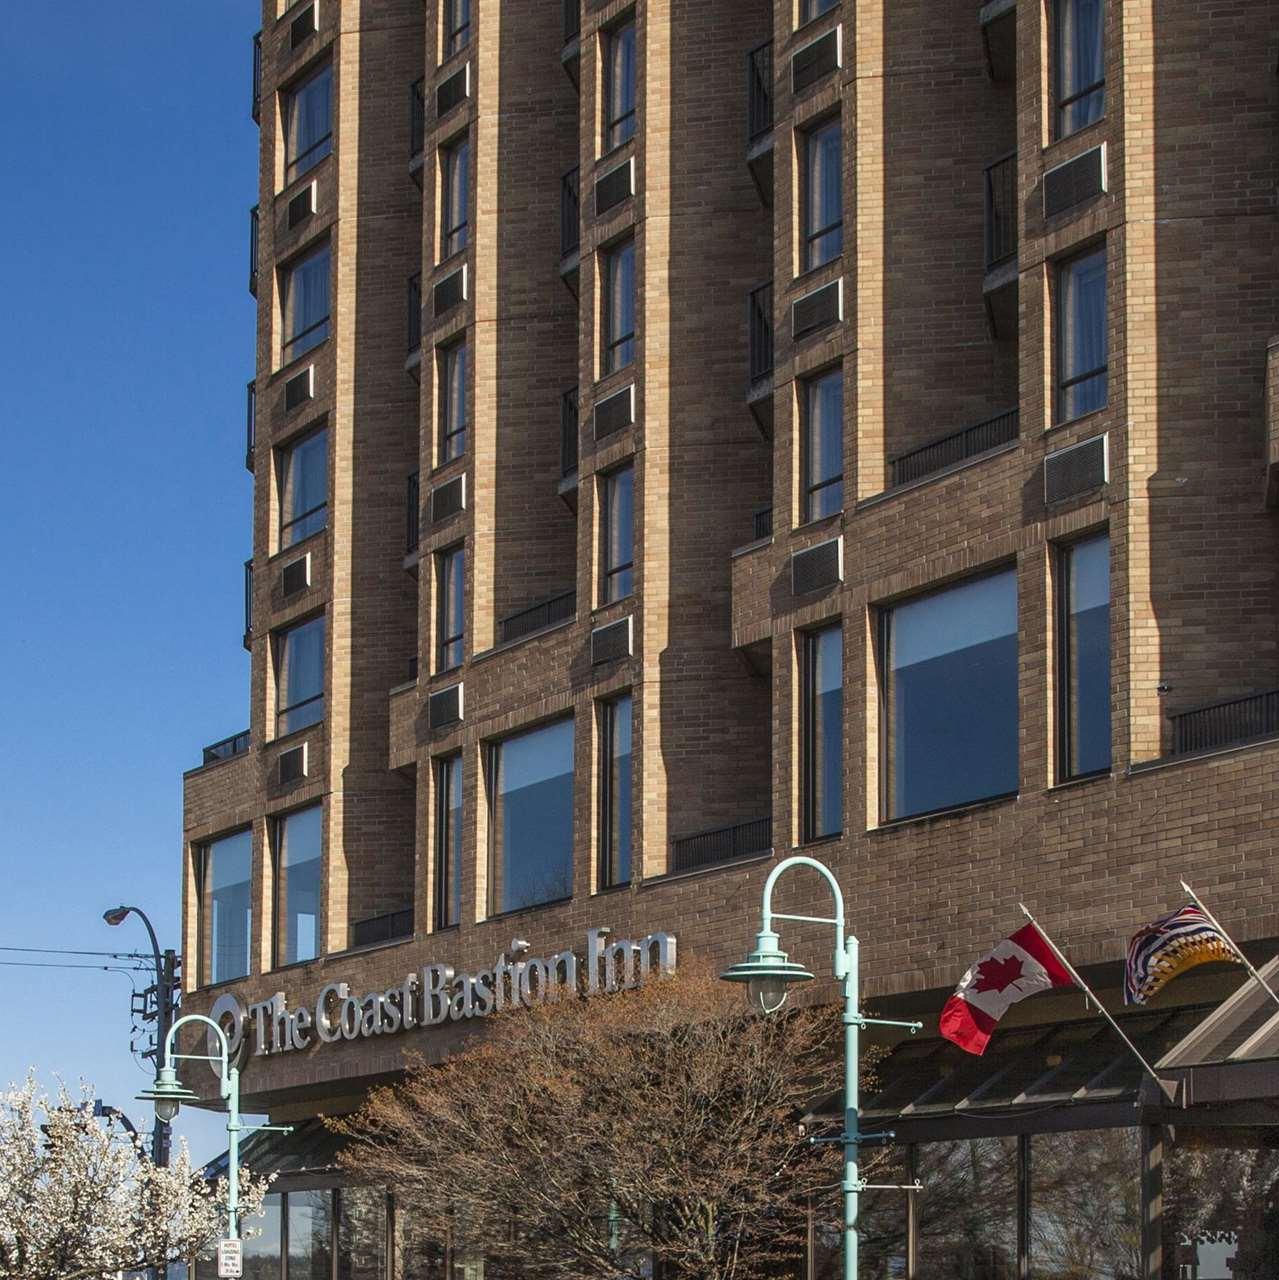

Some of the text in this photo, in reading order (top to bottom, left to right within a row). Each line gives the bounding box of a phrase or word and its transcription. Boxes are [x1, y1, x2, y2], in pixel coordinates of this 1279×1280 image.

[250, 927, 678, 1056] The Coast Bastion Inn
